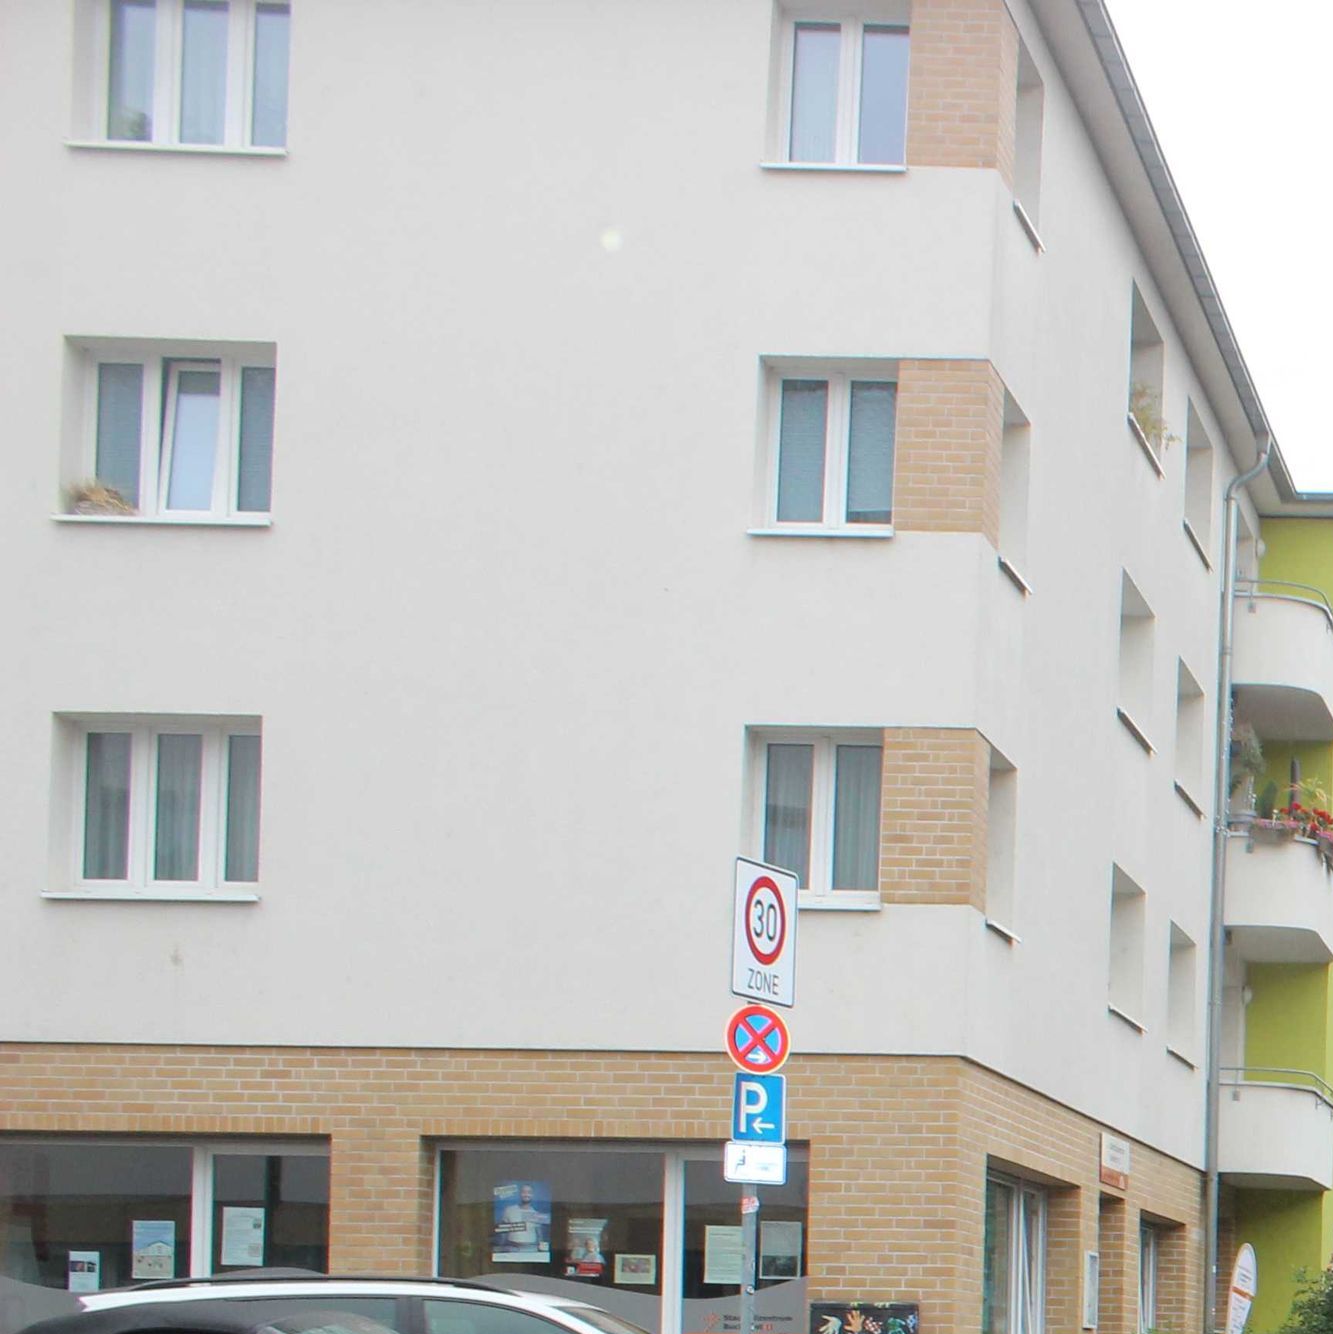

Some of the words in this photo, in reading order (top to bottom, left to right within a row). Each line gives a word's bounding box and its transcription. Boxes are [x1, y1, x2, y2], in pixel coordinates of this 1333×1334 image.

[753, 898, 778, 942] 30
[747, 967, 779, 996] ZONE
[738, 1080, 768, 1133] P
